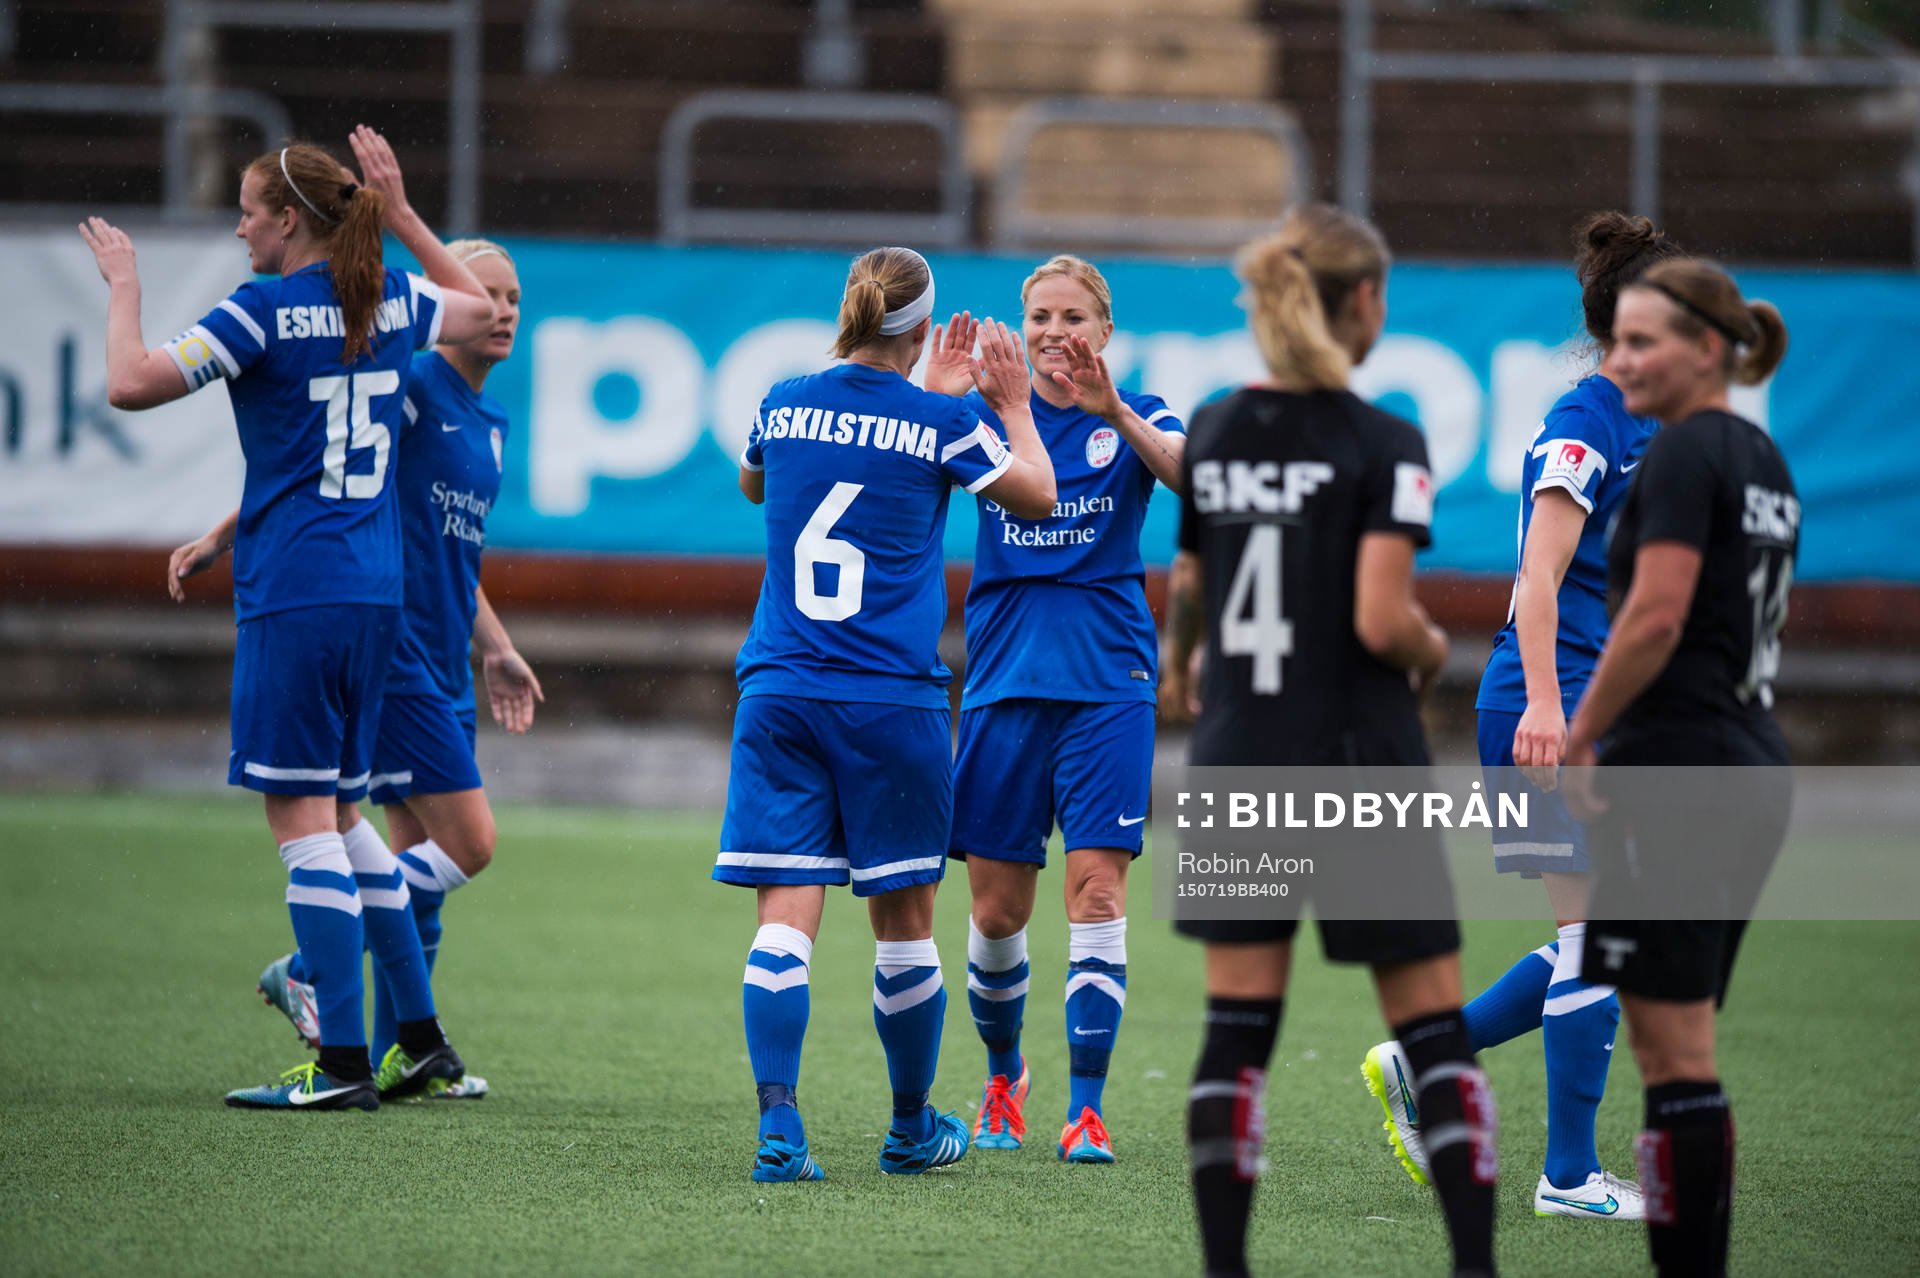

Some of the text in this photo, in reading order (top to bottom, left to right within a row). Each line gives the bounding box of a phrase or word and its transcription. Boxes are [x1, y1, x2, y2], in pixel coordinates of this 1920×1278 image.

[308, 369, 400, 499] 15
[764, 406, 937, 462] ESKILSTUNA
[1192, 460, 1335, 514] SKF
[794, 481, 865, 621] 6
[1002, 522, 1096, 546] Rekarne
[1220, 523, 1294, 695] 4
